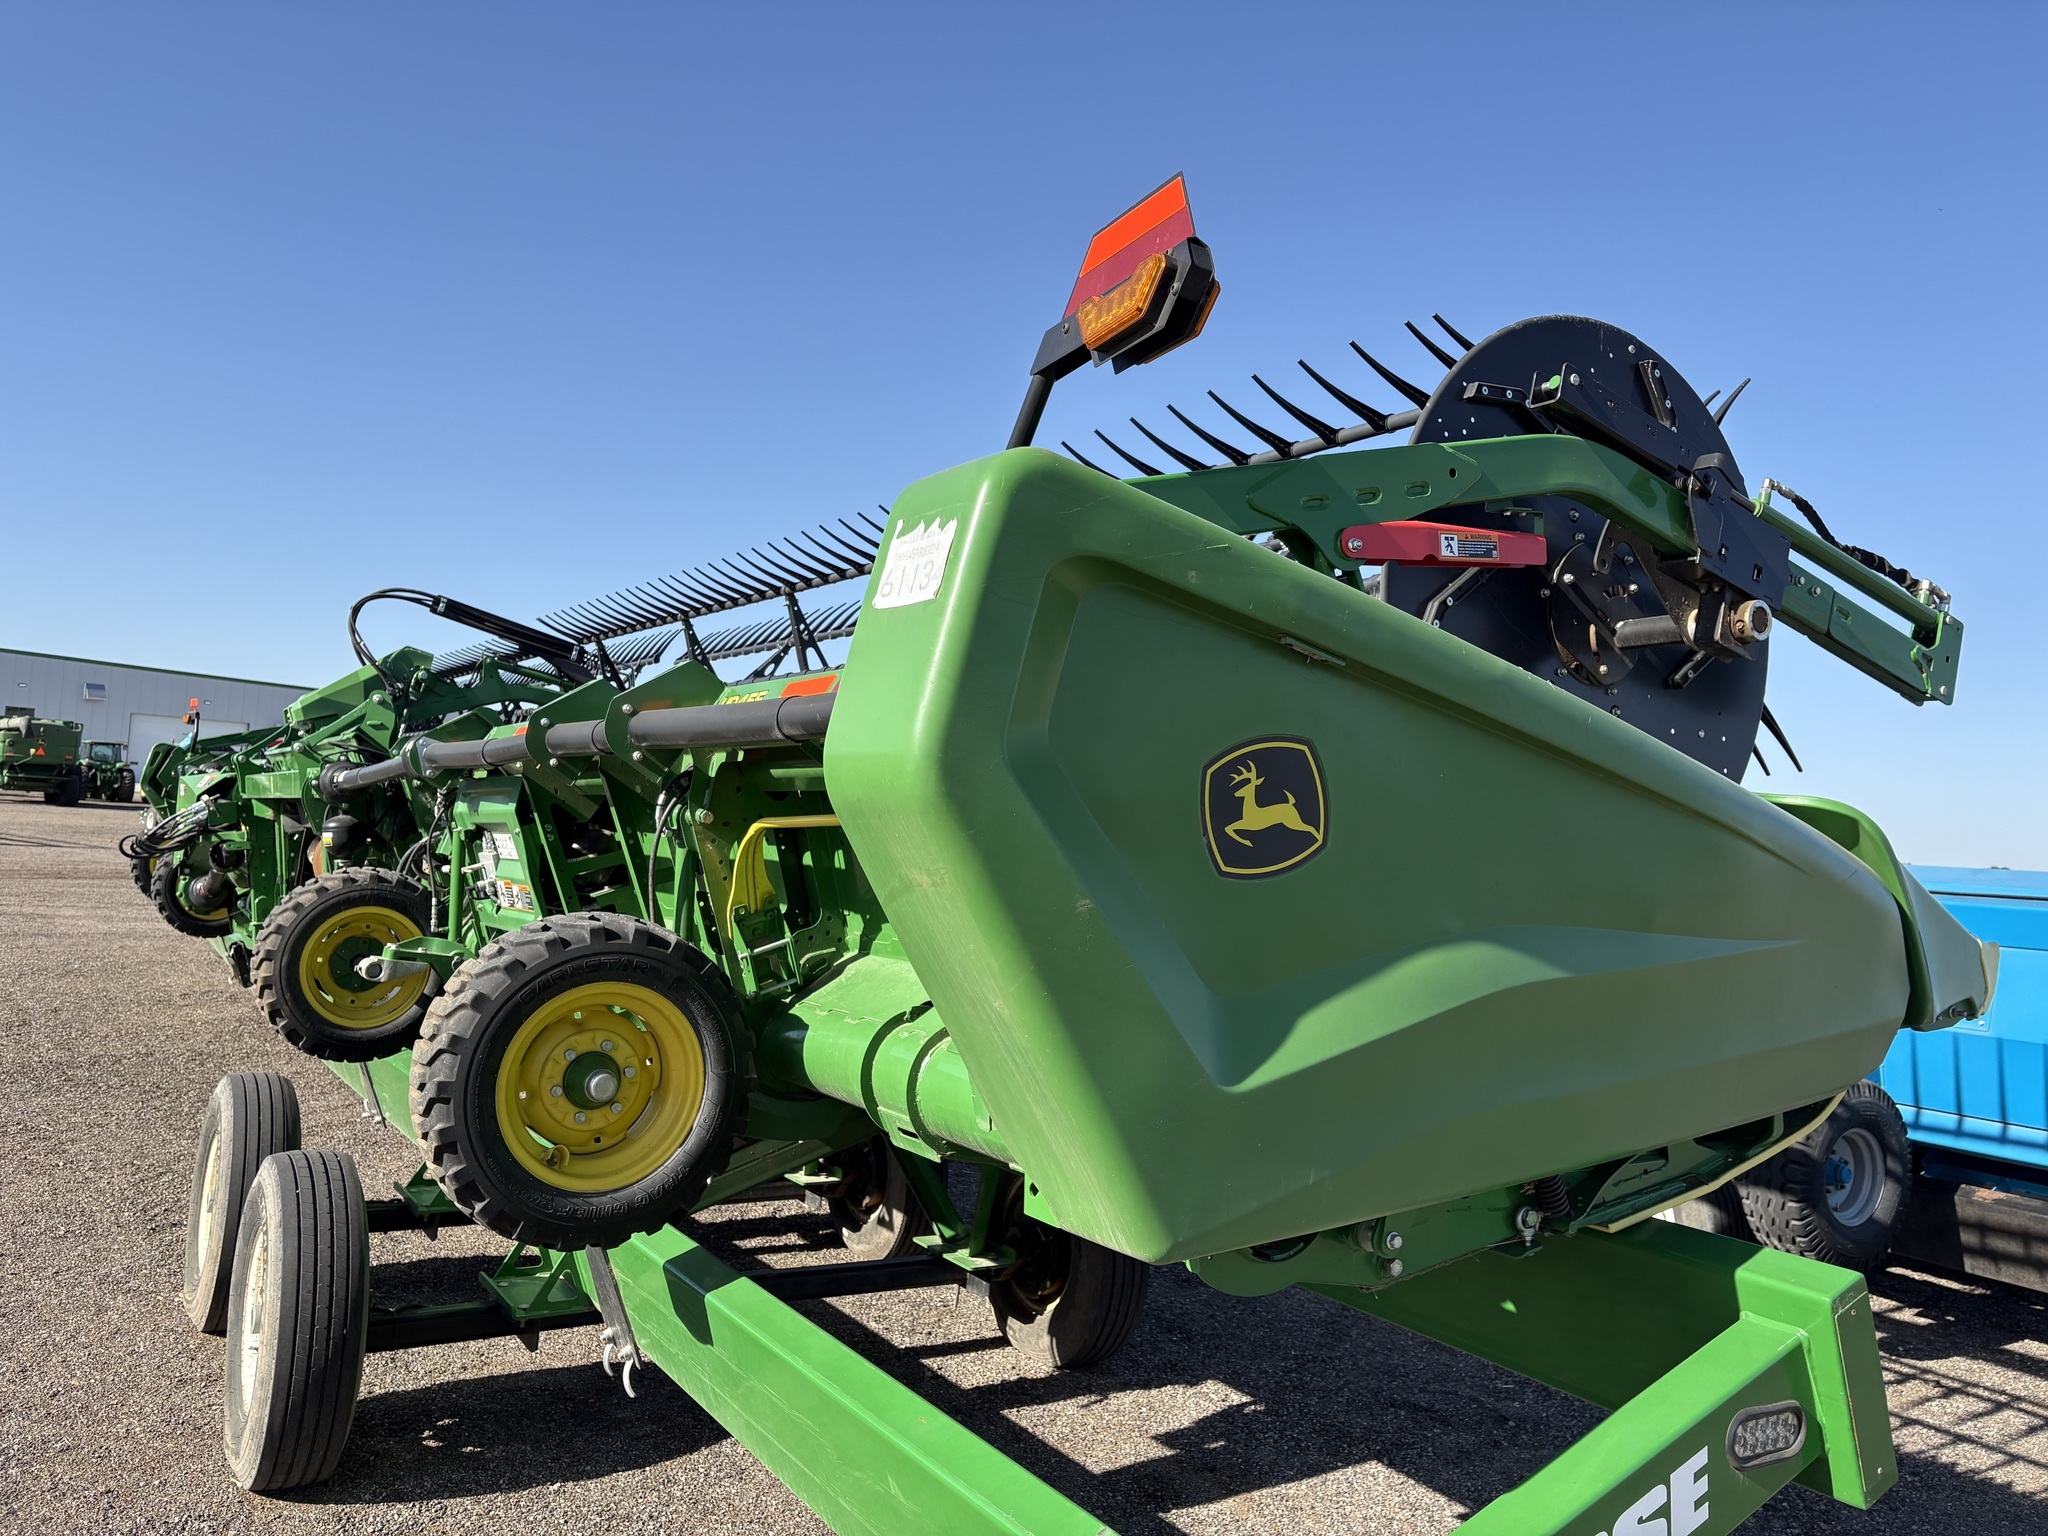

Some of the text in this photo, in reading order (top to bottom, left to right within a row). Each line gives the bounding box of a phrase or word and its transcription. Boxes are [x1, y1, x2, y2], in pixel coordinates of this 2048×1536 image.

[518, 957, 650, 1004] CARLSTAR
[557, 1164, 690, 1219] TRAC CHIEF
[1594, 1445, 1709, 1536] SE
